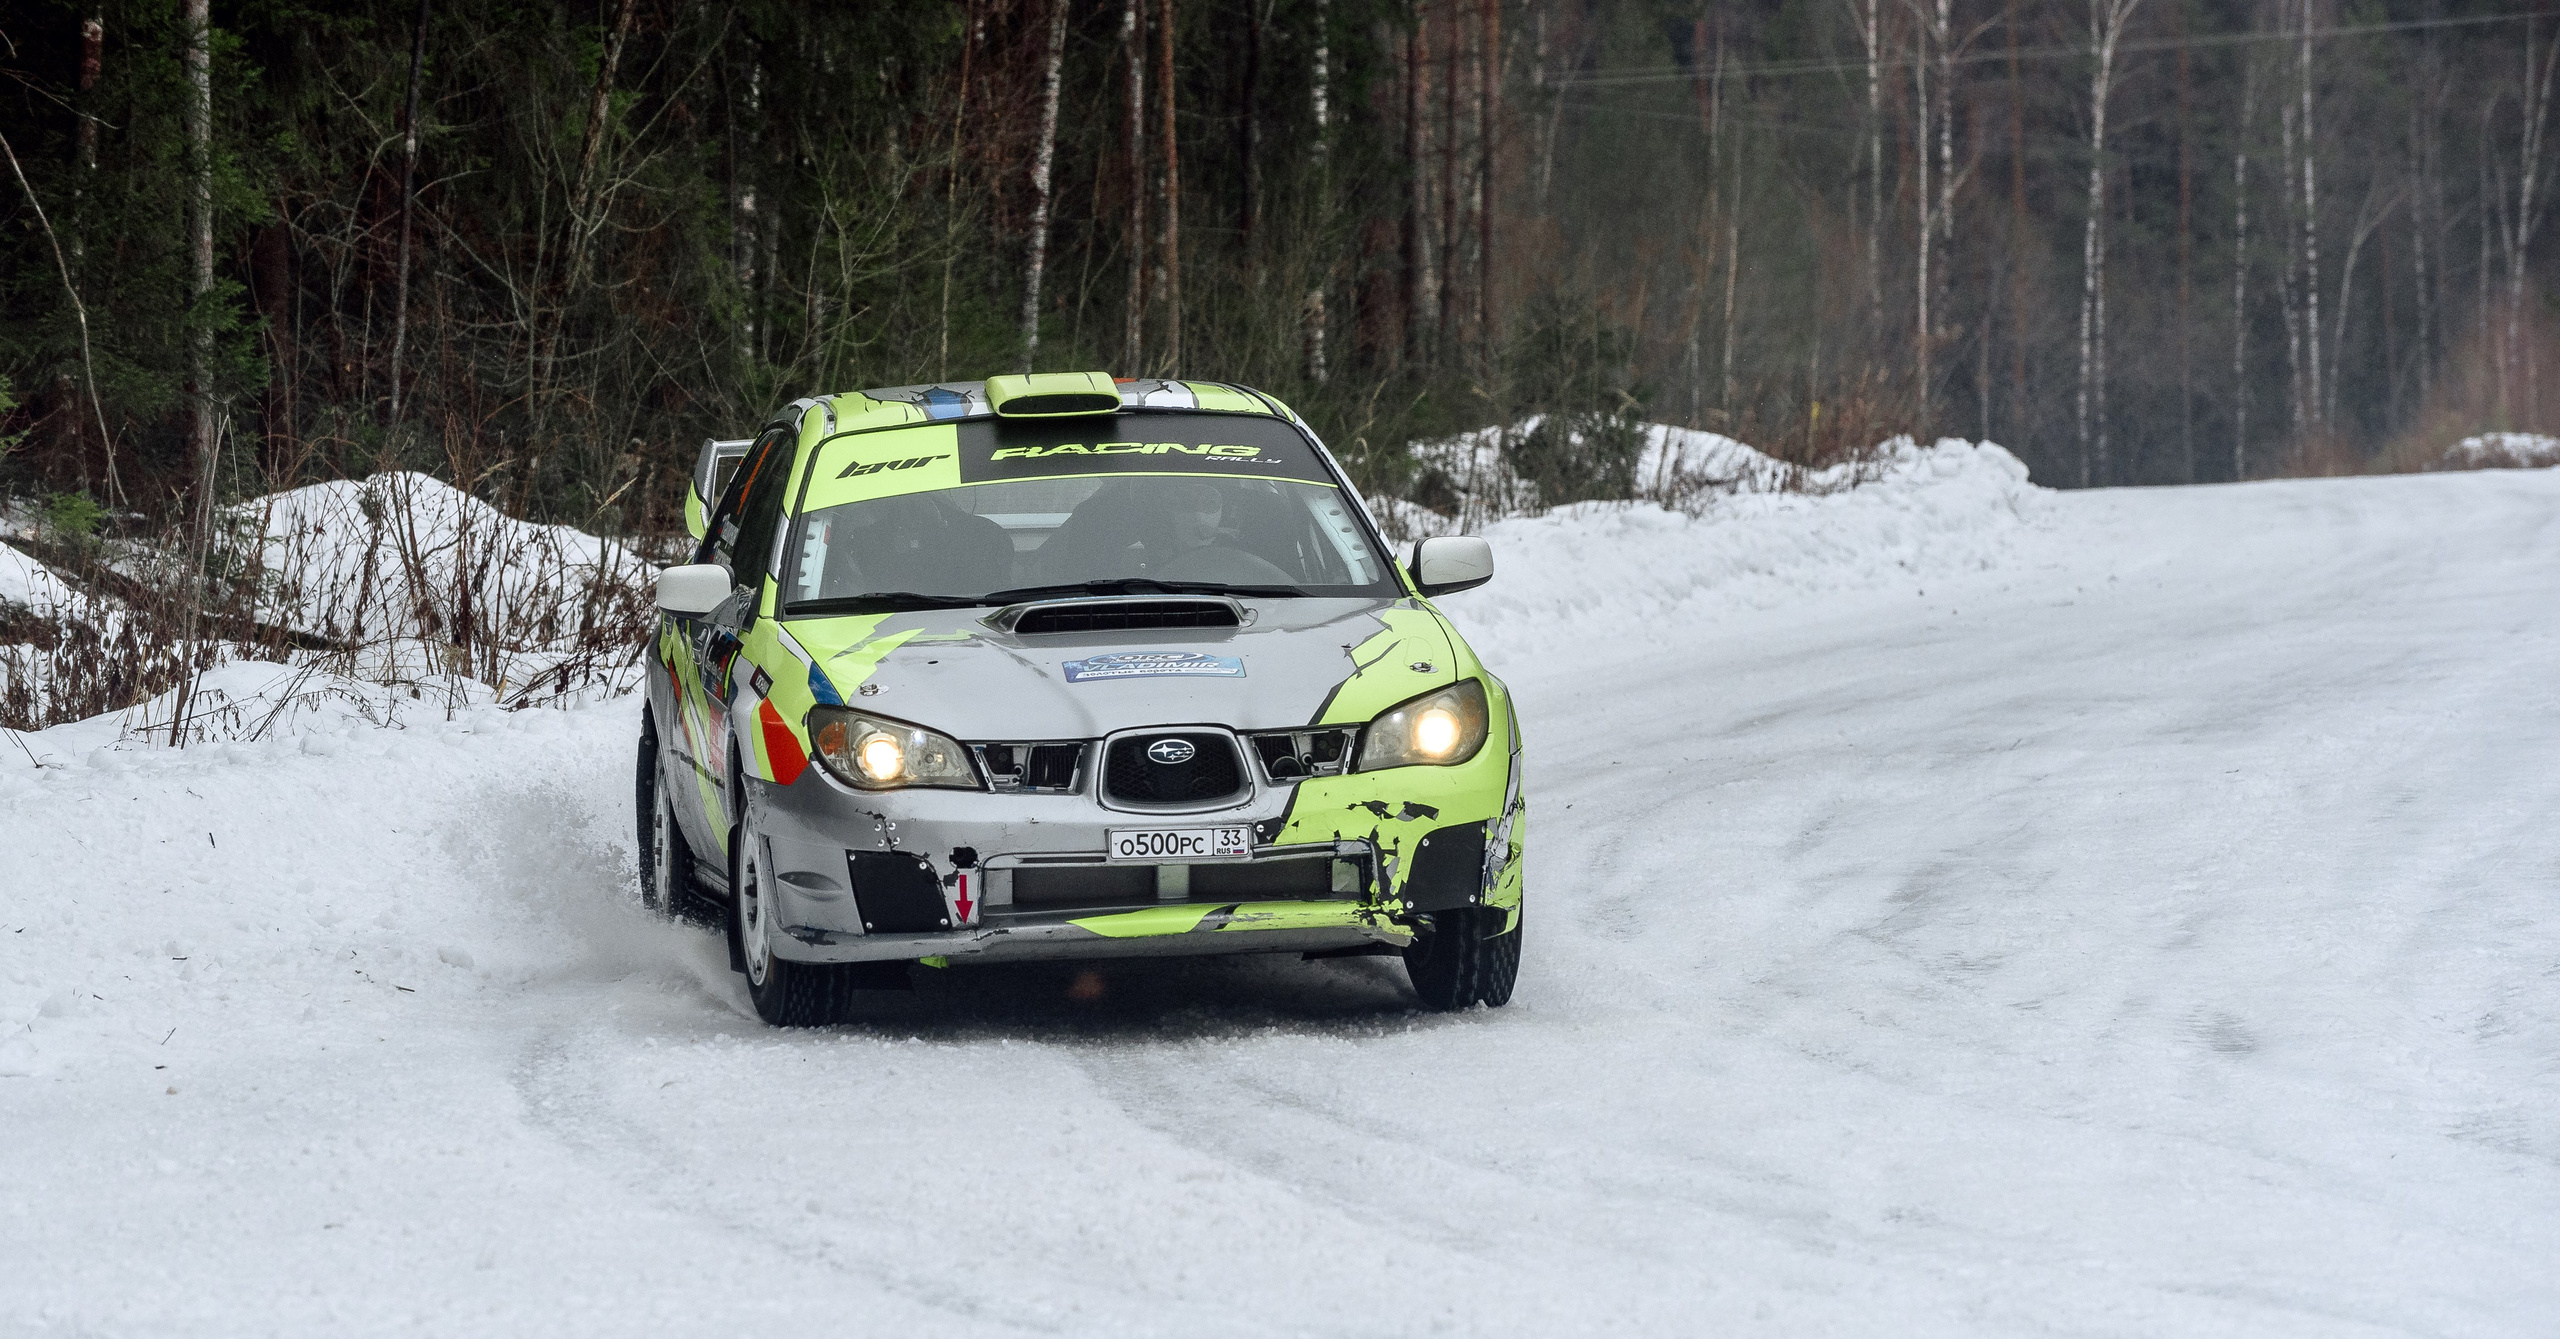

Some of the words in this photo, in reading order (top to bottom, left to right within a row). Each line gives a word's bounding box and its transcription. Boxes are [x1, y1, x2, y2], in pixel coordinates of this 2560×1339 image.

[990, 442, 1261, 461] RACING
[1204, 455, 1283, 464] RALLY
[1083, 661, 1221, 672] VLADIMIR
[1220, 829, 1241, 846] 33
[1216, 847, 1231, 855] RUS
